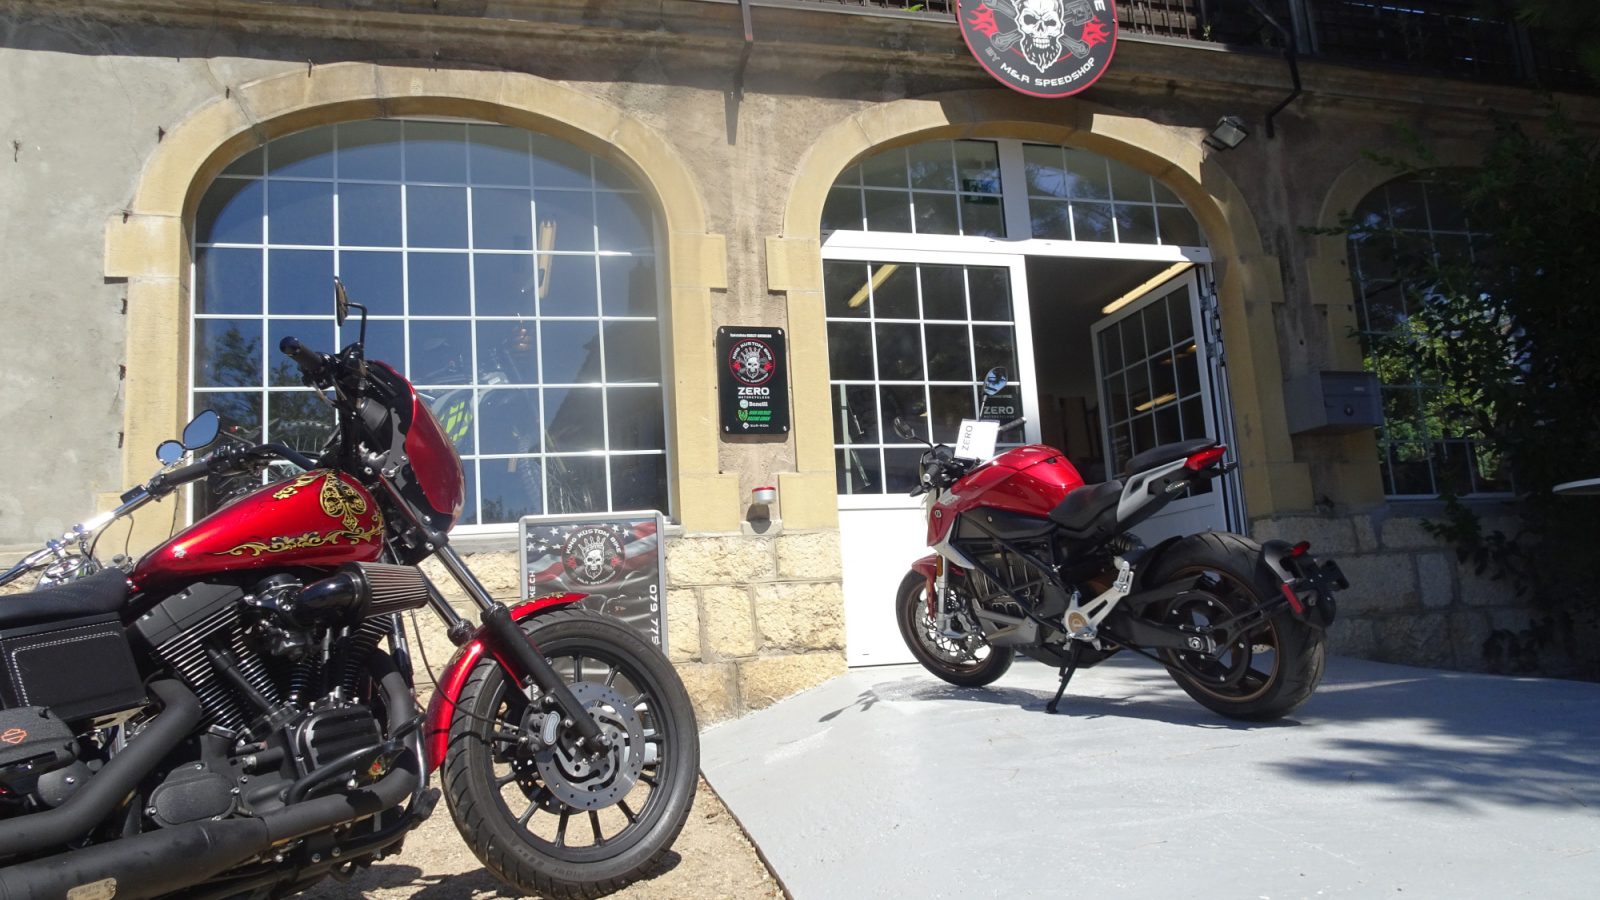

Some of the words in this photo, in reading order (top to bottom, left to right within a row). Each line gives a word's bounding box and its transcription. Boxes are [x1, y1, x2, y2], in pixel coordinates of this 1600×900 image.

[984, 46, 1000, 62] BY
[1000, 62, 1030, 83] M&R
[1034, 57, 1096, 87] SPEEDSHOP
[737, 386, 770, 395] ZERO
[983, 406, 1015, 415] ZERO
[961, 425, 973, 451] ZERO
[577, 528, 610, 538] KUSTOM
[649, 584, 658, 612] 079
[650, 618, 660, 646] 775
